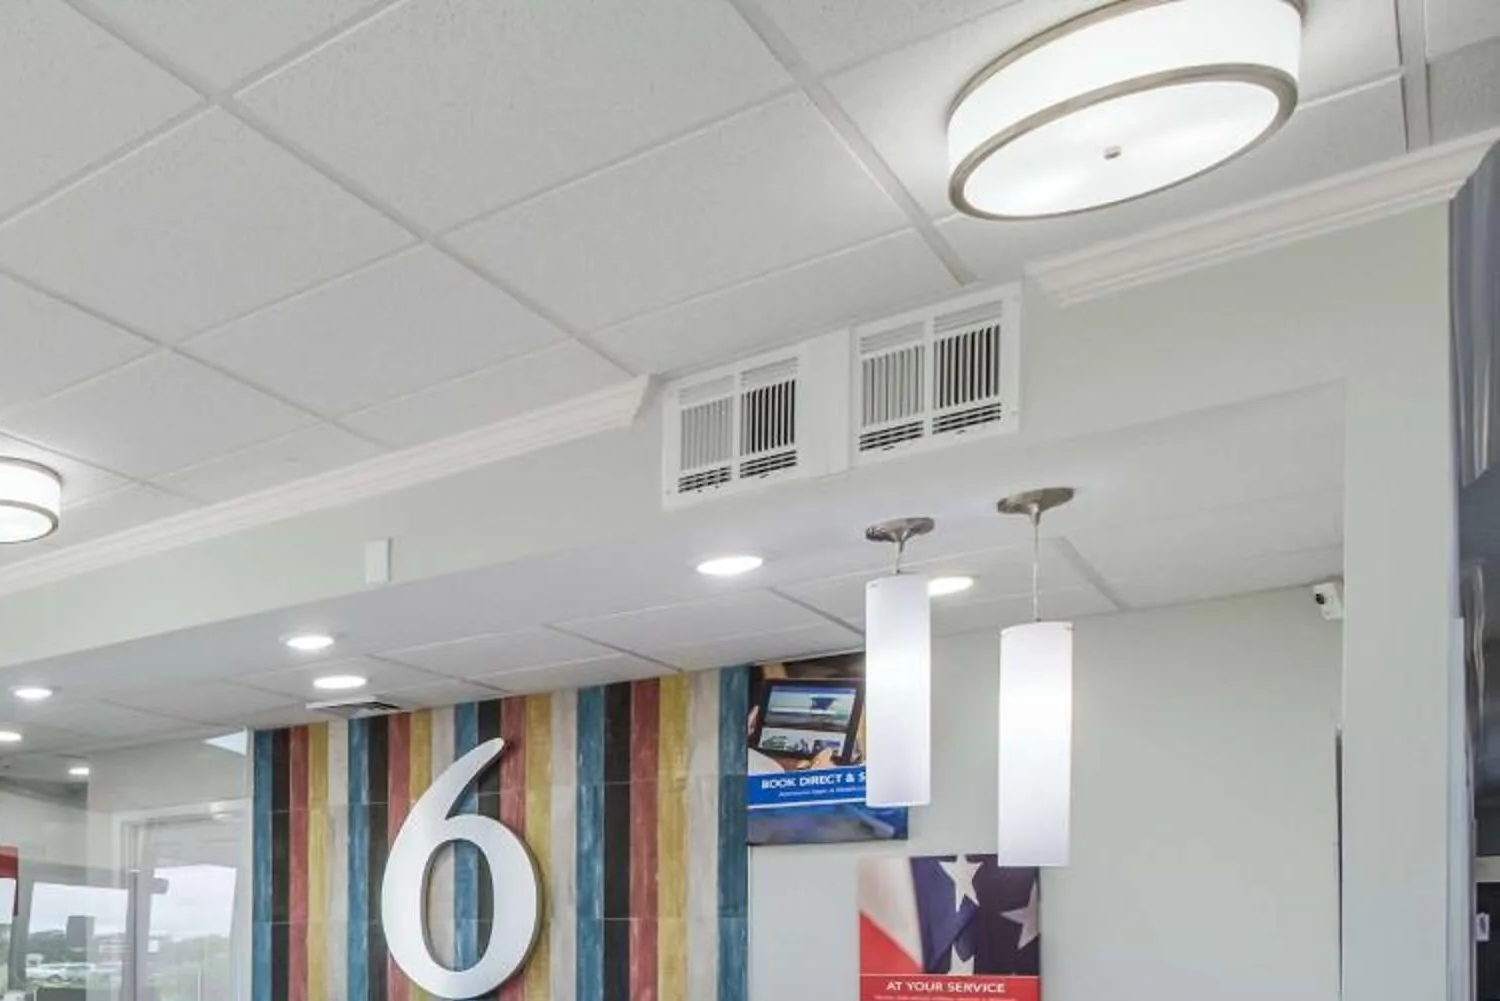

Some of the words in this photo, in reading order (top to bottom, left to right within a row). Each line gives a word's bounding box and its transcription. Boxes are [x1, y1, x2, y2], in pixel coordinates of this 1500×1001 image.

[761, 779, 797, 789] BOOK
[799, 774, 841, 786] DIRECT
[844, 772, 855, 783] &
[381, 737, 542, 1000] 6
[886, 981, 902, 991] AT
[906, 982, 943, 992] YOUR
[947, 982, 1006, 993] SERVICE
